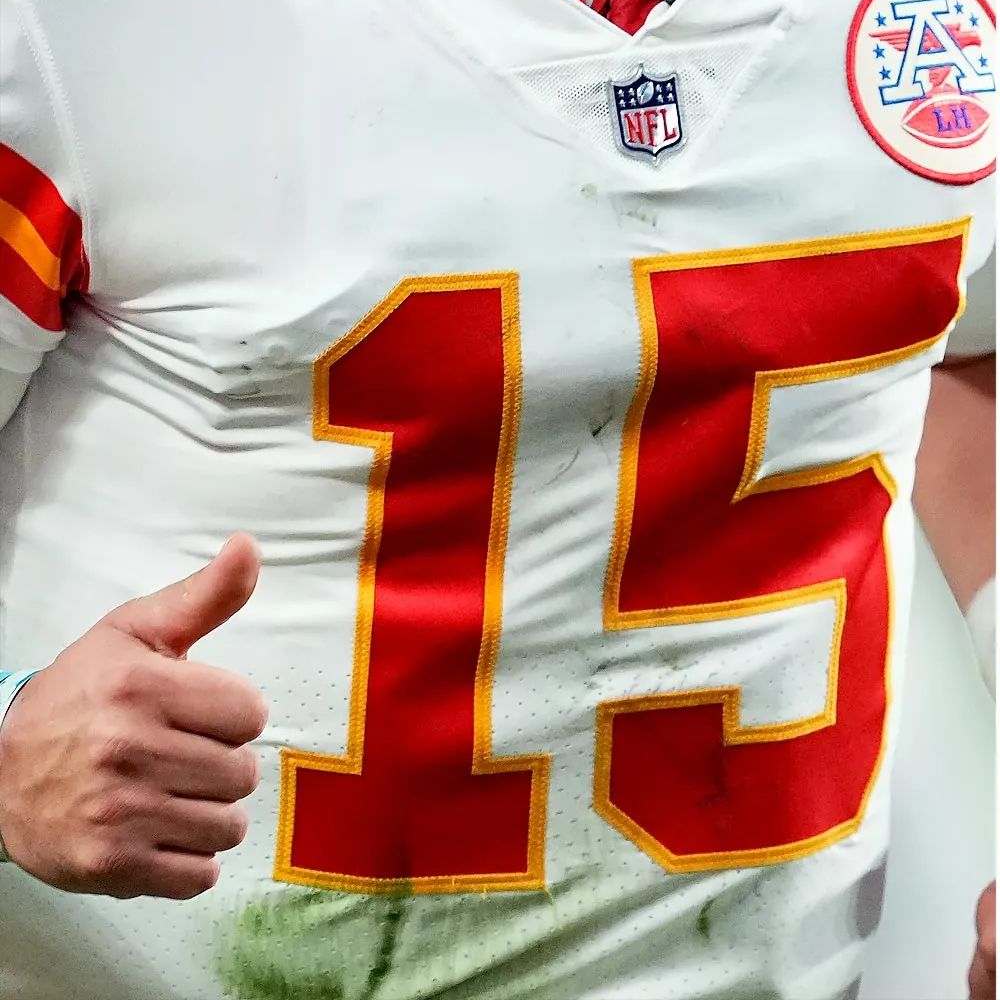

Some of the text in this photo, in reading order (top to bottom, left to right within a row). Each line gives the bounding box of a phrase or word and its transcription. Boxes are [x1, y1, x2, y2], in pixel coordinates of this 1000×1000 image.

[623, 108, 677, 147] NFL
[932, 105, 972, 133] LH
[272, 215, 974, 892] 15
